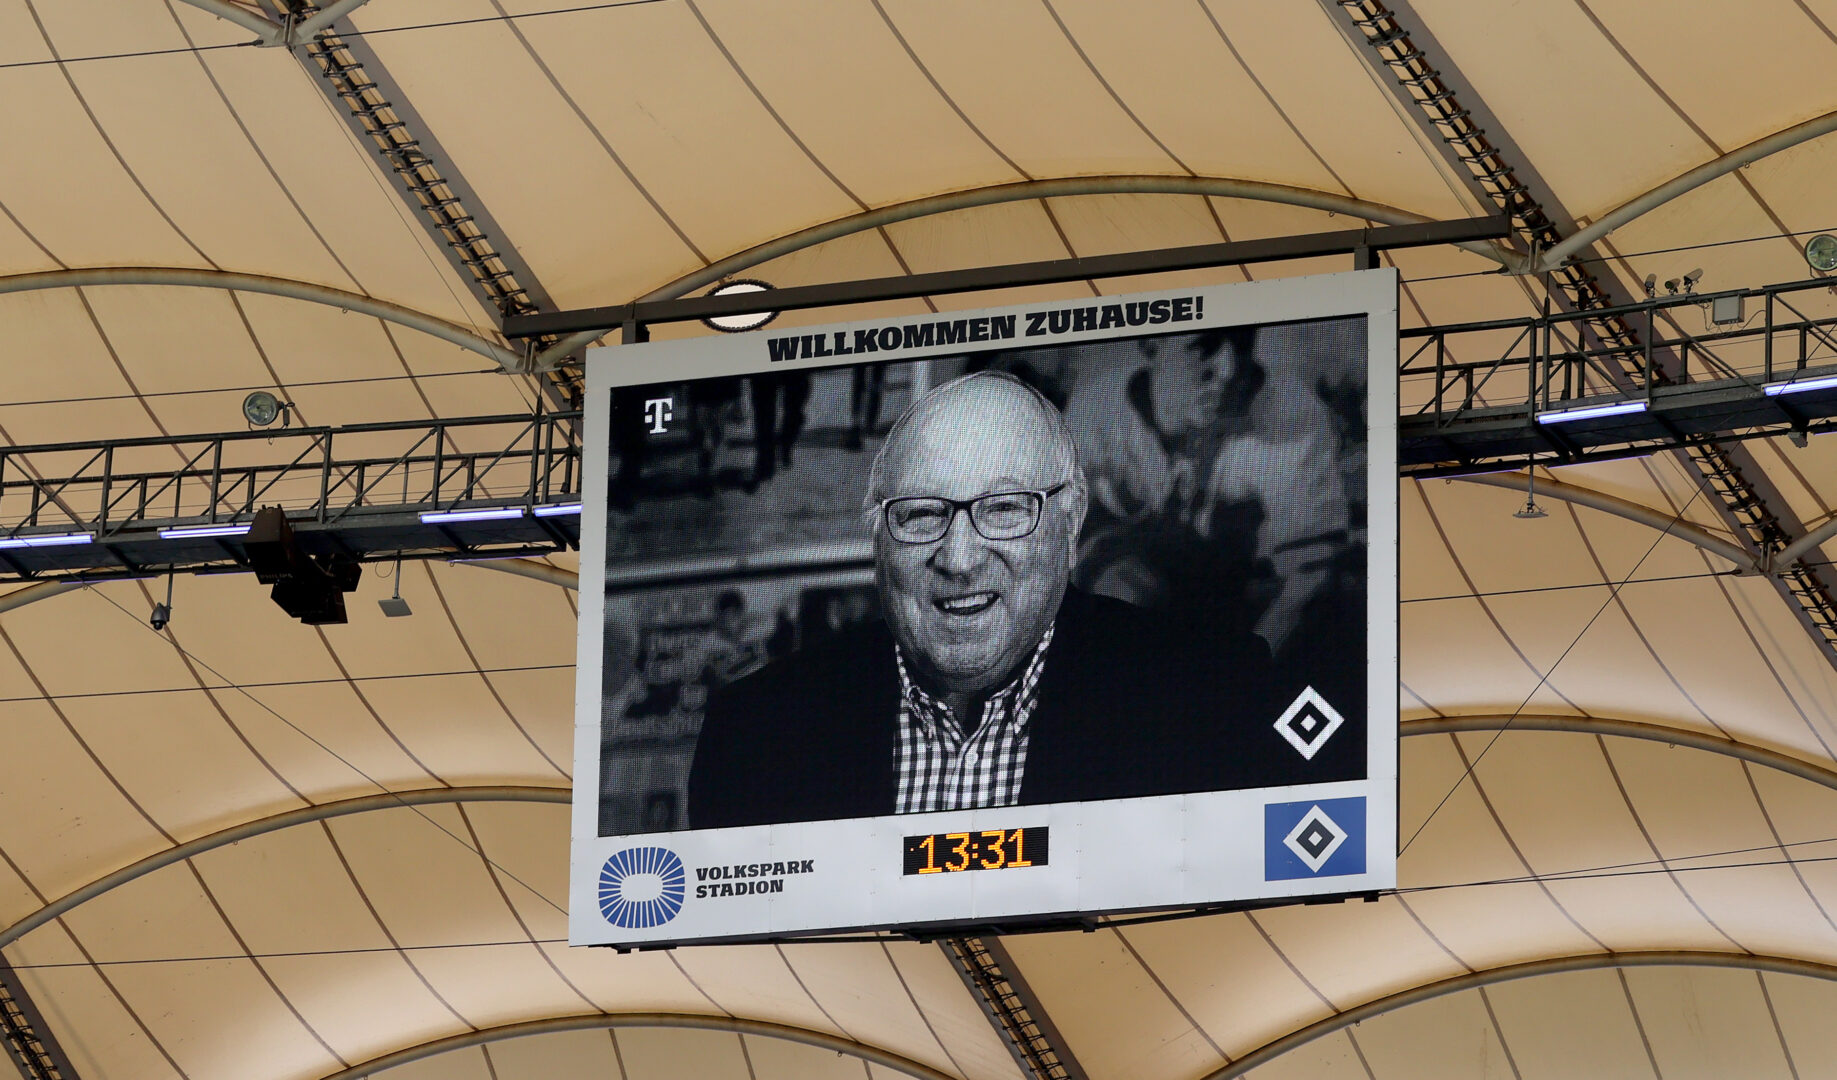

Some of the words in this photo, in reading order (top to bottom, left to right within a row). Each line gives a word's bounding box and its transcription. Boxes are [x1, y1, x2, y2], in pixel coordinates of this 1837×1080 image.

[767, 314, 1017, 363] WILLKOMMEN
[1025, 296, 1204, 337] ZUHAUSE!
[919, 828, 1032, 874] 13:31
[696, 860, 814, 882] VOLKSPARK
[696, 880, 784, 899] STADION
